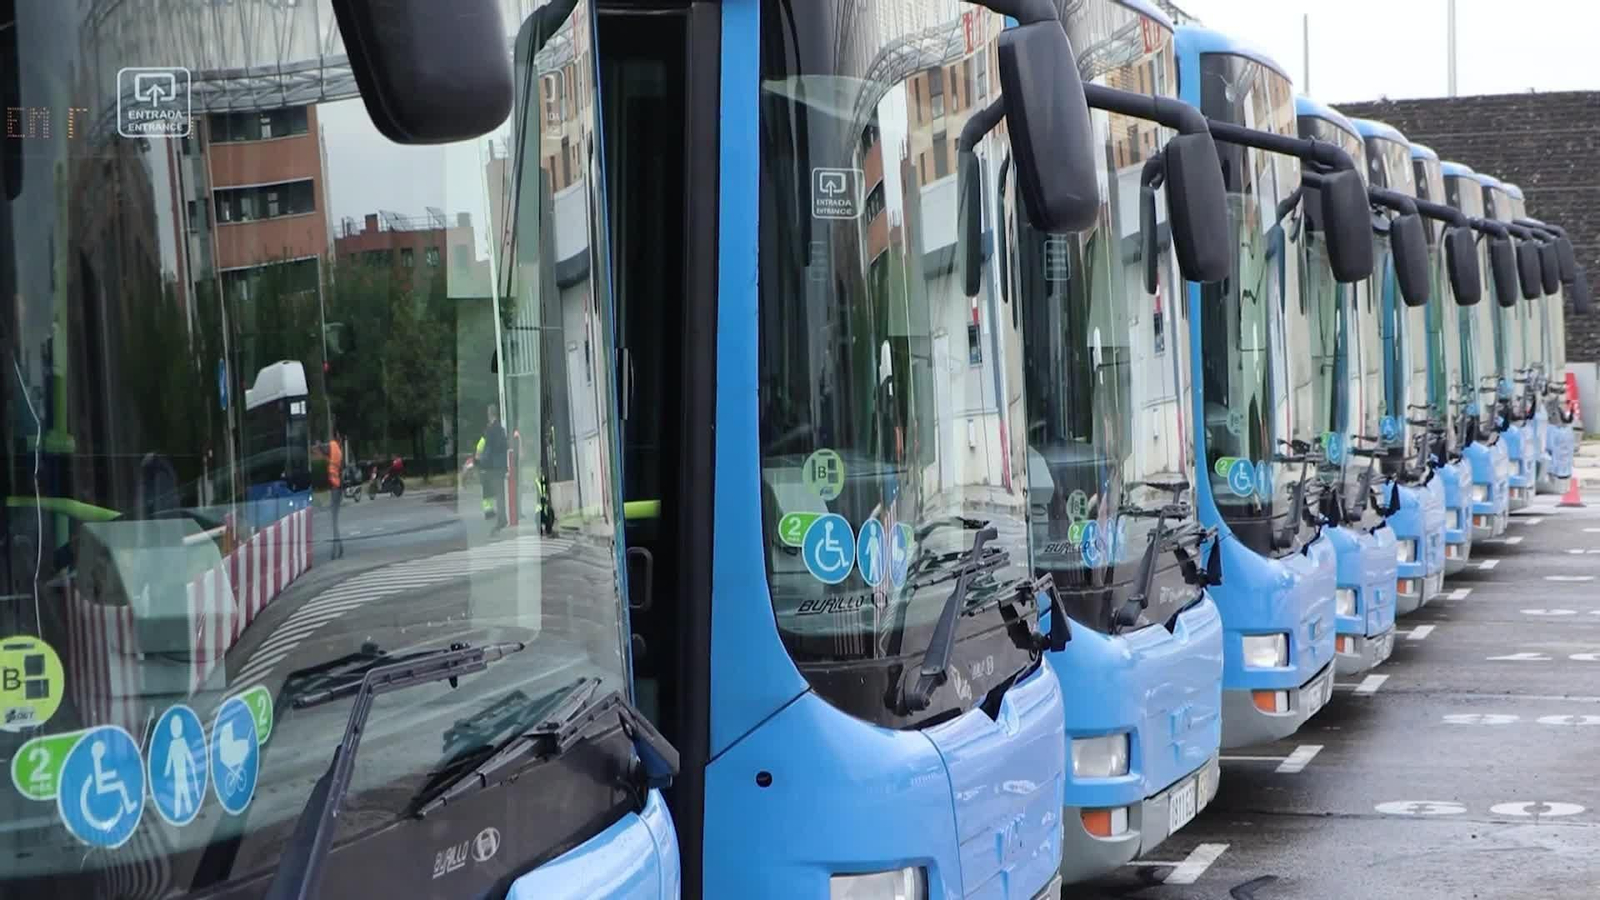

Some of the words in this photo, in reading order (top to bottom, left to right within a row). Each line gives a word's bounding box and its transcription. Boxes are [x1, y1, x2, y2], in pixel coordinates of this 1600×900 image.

[128, 110, 183, 120] ENTRADA
[128, 123, 183, 132] ENTRANCE
[817, 466, 827, 479] B
[788, 517, 801, 535] 2
[3, 669, 20, 690] B
[258, 695, 268, 727] 2
[29, 747, 53, 782] 2
